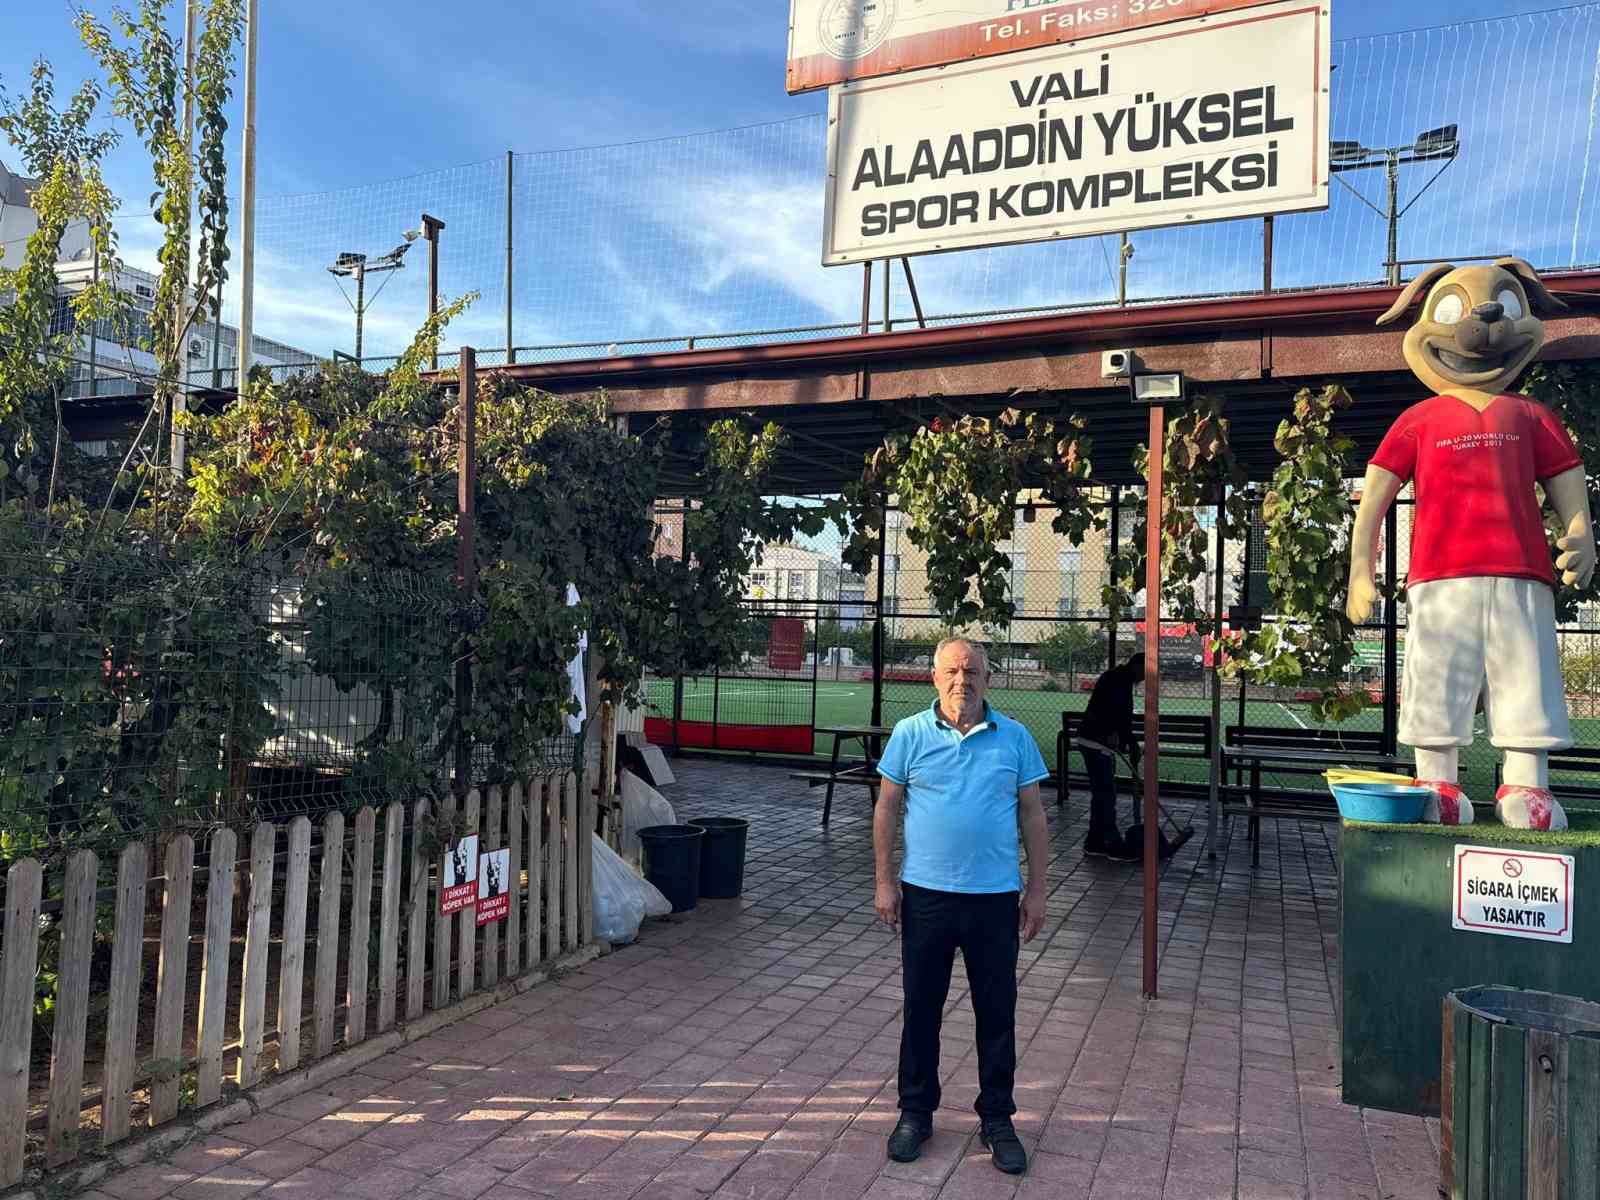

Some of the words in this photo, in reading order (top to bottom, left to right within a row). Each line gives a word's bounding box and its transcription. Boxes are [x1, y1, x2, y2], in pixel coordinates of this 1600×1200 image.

[981, 19, 1030, 41] Tel.
[1040, 4, 1118, 32] Faks:
[1010, 53, 1109, 108] VALİ
[852, 109, 1083, 191] ALAADDİN
[1093, 85, 1294, 156] YÜKSEL
[861, 191, 979, 237] SPOR
[988, 140, 1278, 221] KOMPLEKSİ
[1436, 439, 1453, 448] FIFA
[1454, 434, 1472, 444] U-20
[1472, 432, 1504, 441] WORLD
[1452, 440, 1480, 451] TURKEY
[1467, 876, 1514, 898] SİGARA
[1518, 881, 1559, 904] İÇMEK
[442, 899, 462, 912] KÖPEK
[463, 895, 475, 905] VAR
[496, 906, 507, 915] VAR
[1483, 906, 1546, 928] YASAKTIR
